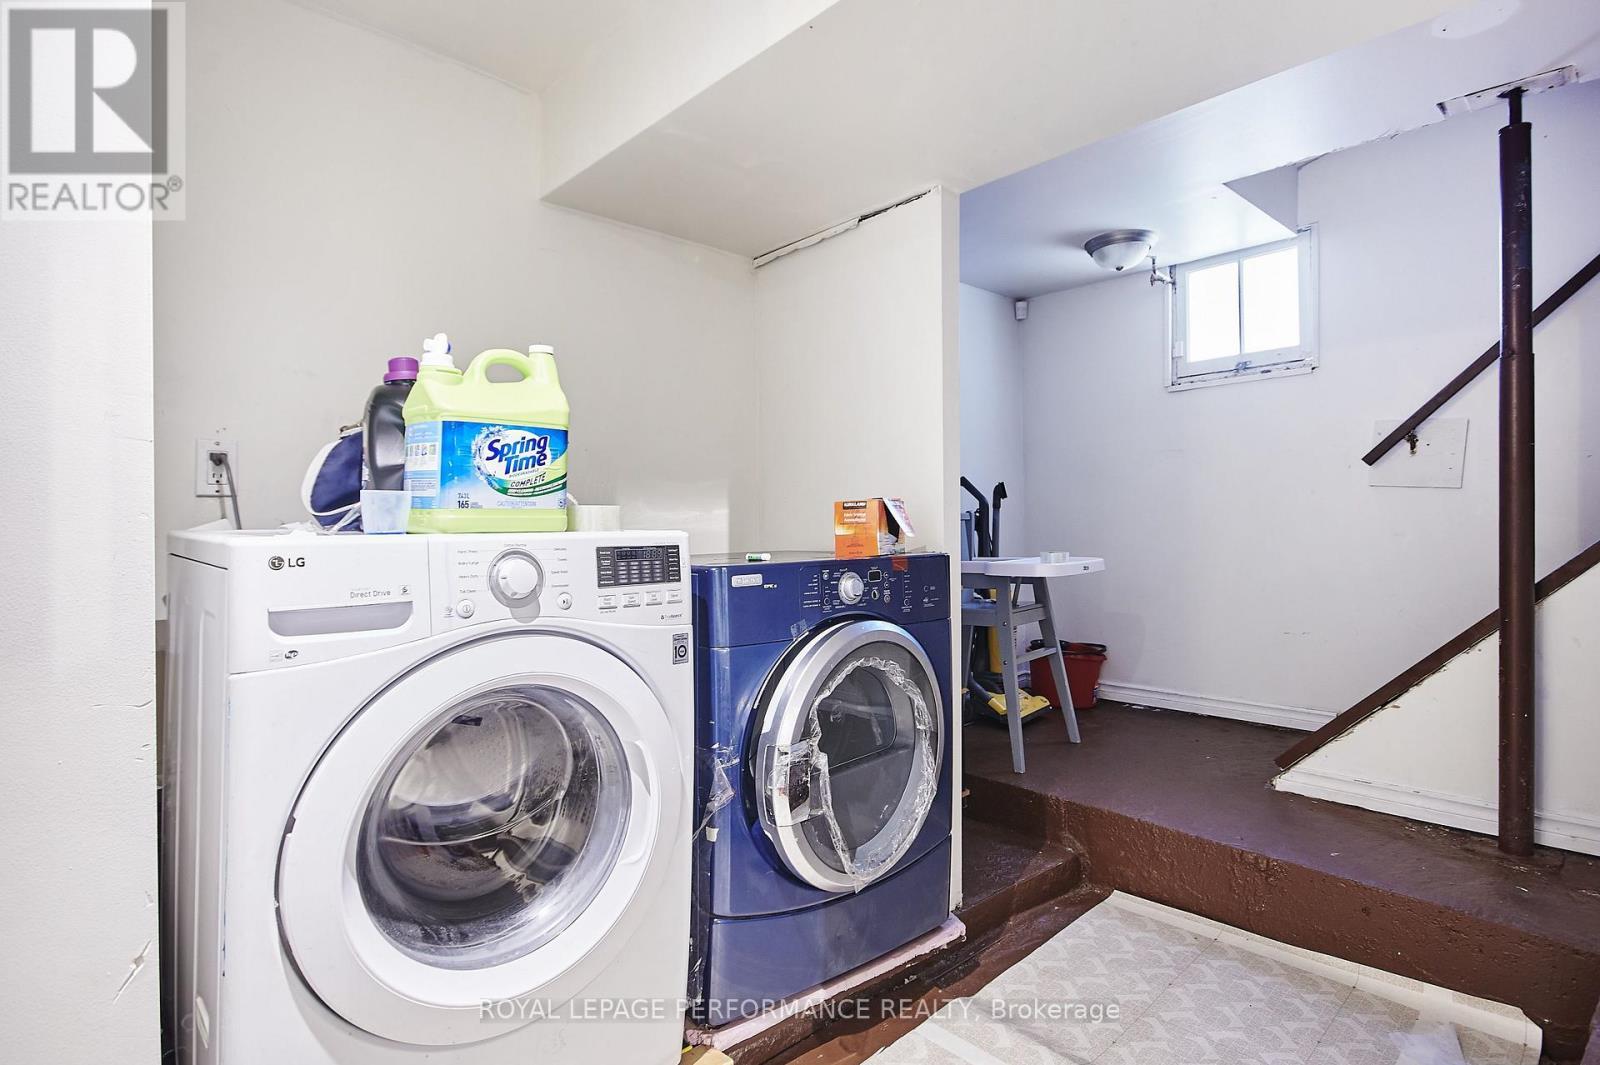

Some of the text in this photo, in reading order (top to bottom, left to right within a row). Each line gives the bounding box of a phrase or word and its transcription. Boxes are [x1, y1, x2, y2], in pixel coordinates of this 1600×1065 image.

[485, 436, 549, 463] Spring
[504, 452, 548, 475] Time
[510, 471, 547, 488] COMPLETE
[457, 500, 470, 509] 165
[288, 557, 306, 568] LG
[350, 591, 371, 600] Direct
[372, 589, 391, 598] Drive
[674, 644, 687, 659] 10
